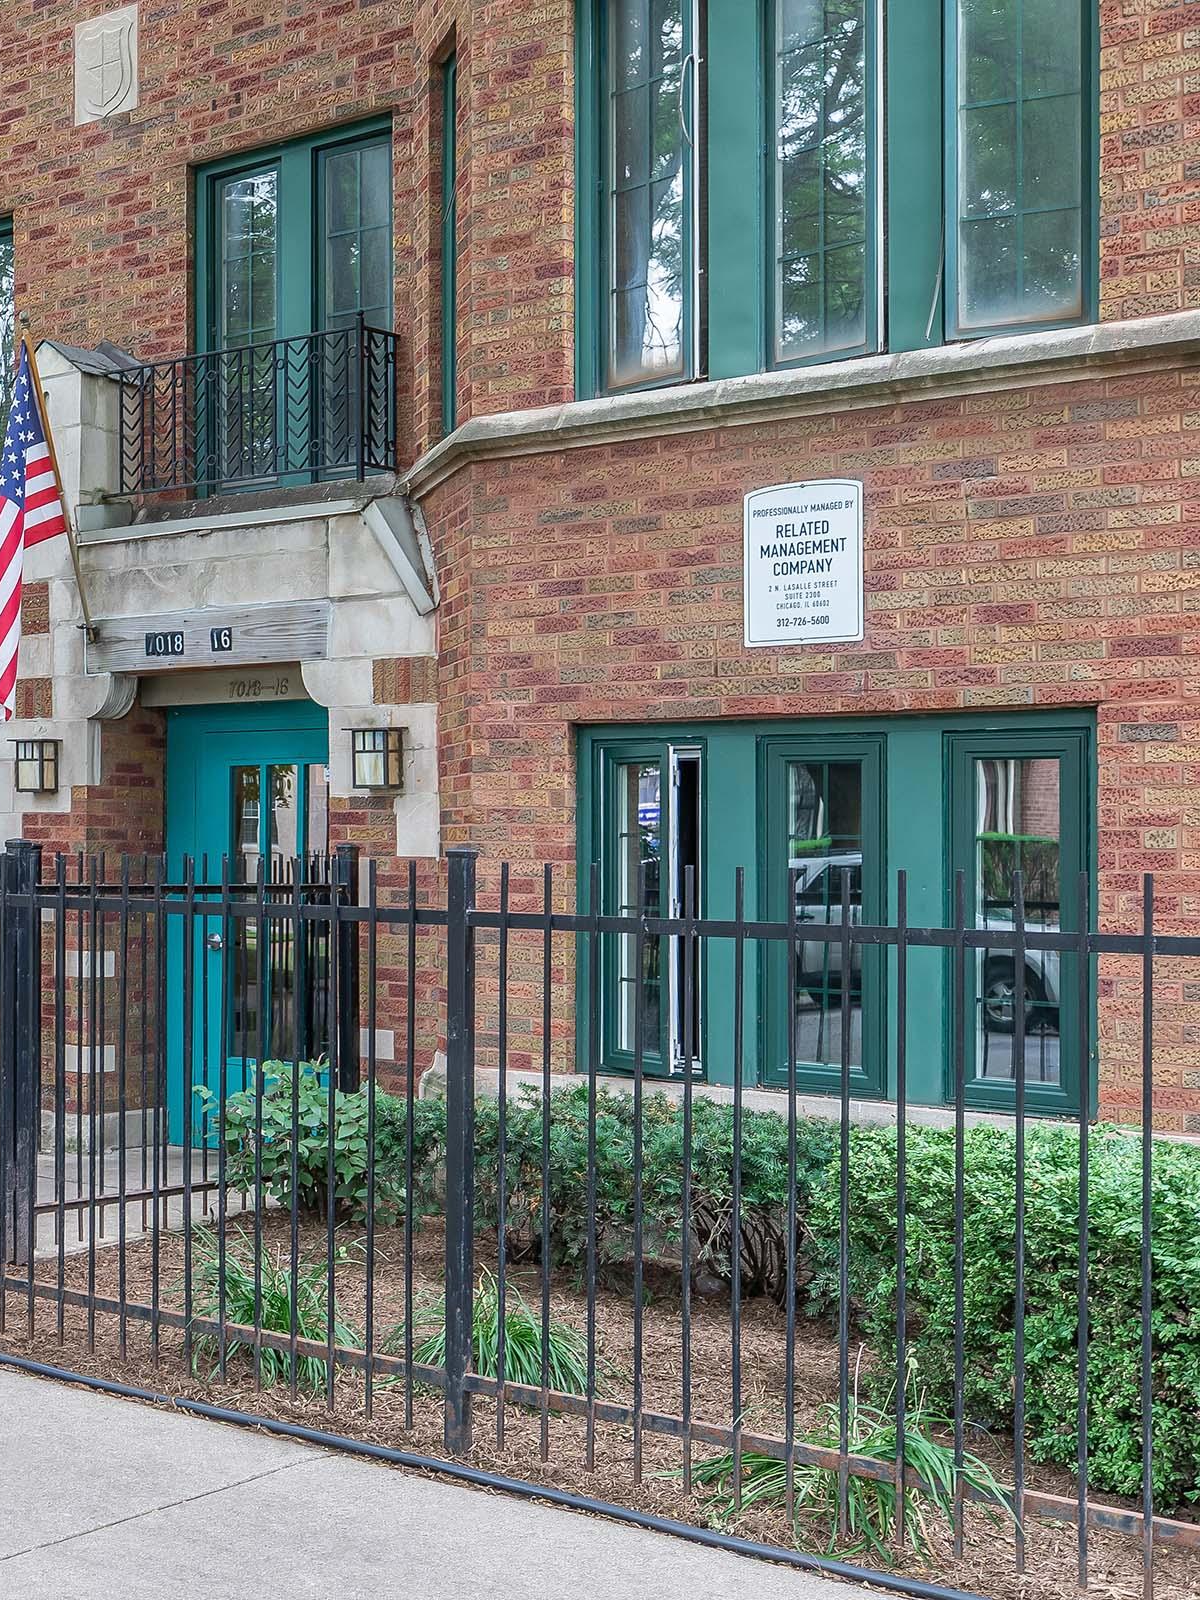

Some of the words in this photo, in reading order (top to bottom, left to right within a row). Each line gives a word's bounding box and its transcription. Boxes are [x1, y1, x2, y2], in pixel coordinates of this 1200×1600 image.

[753, 504, 808, 518] PROFESSIONALLY
[810, 501, 843, 512] MANAGED
[845, 500, 854, 509] BY
[776, 520, 829, 539] RELATED
[760, 537, 847, 559] MANAGEMENT
[773, 558, 833, 577] COMPANY
[783, 582, 811, 592] LASALLE
[813, 580, 838, 589] STREET
[784, 592, 803, 601] SUITE
[804, 600, 810, 608] IL
[776, 615, 830, 628] 312-726-5600
[213, 629, 231, 649] 16
